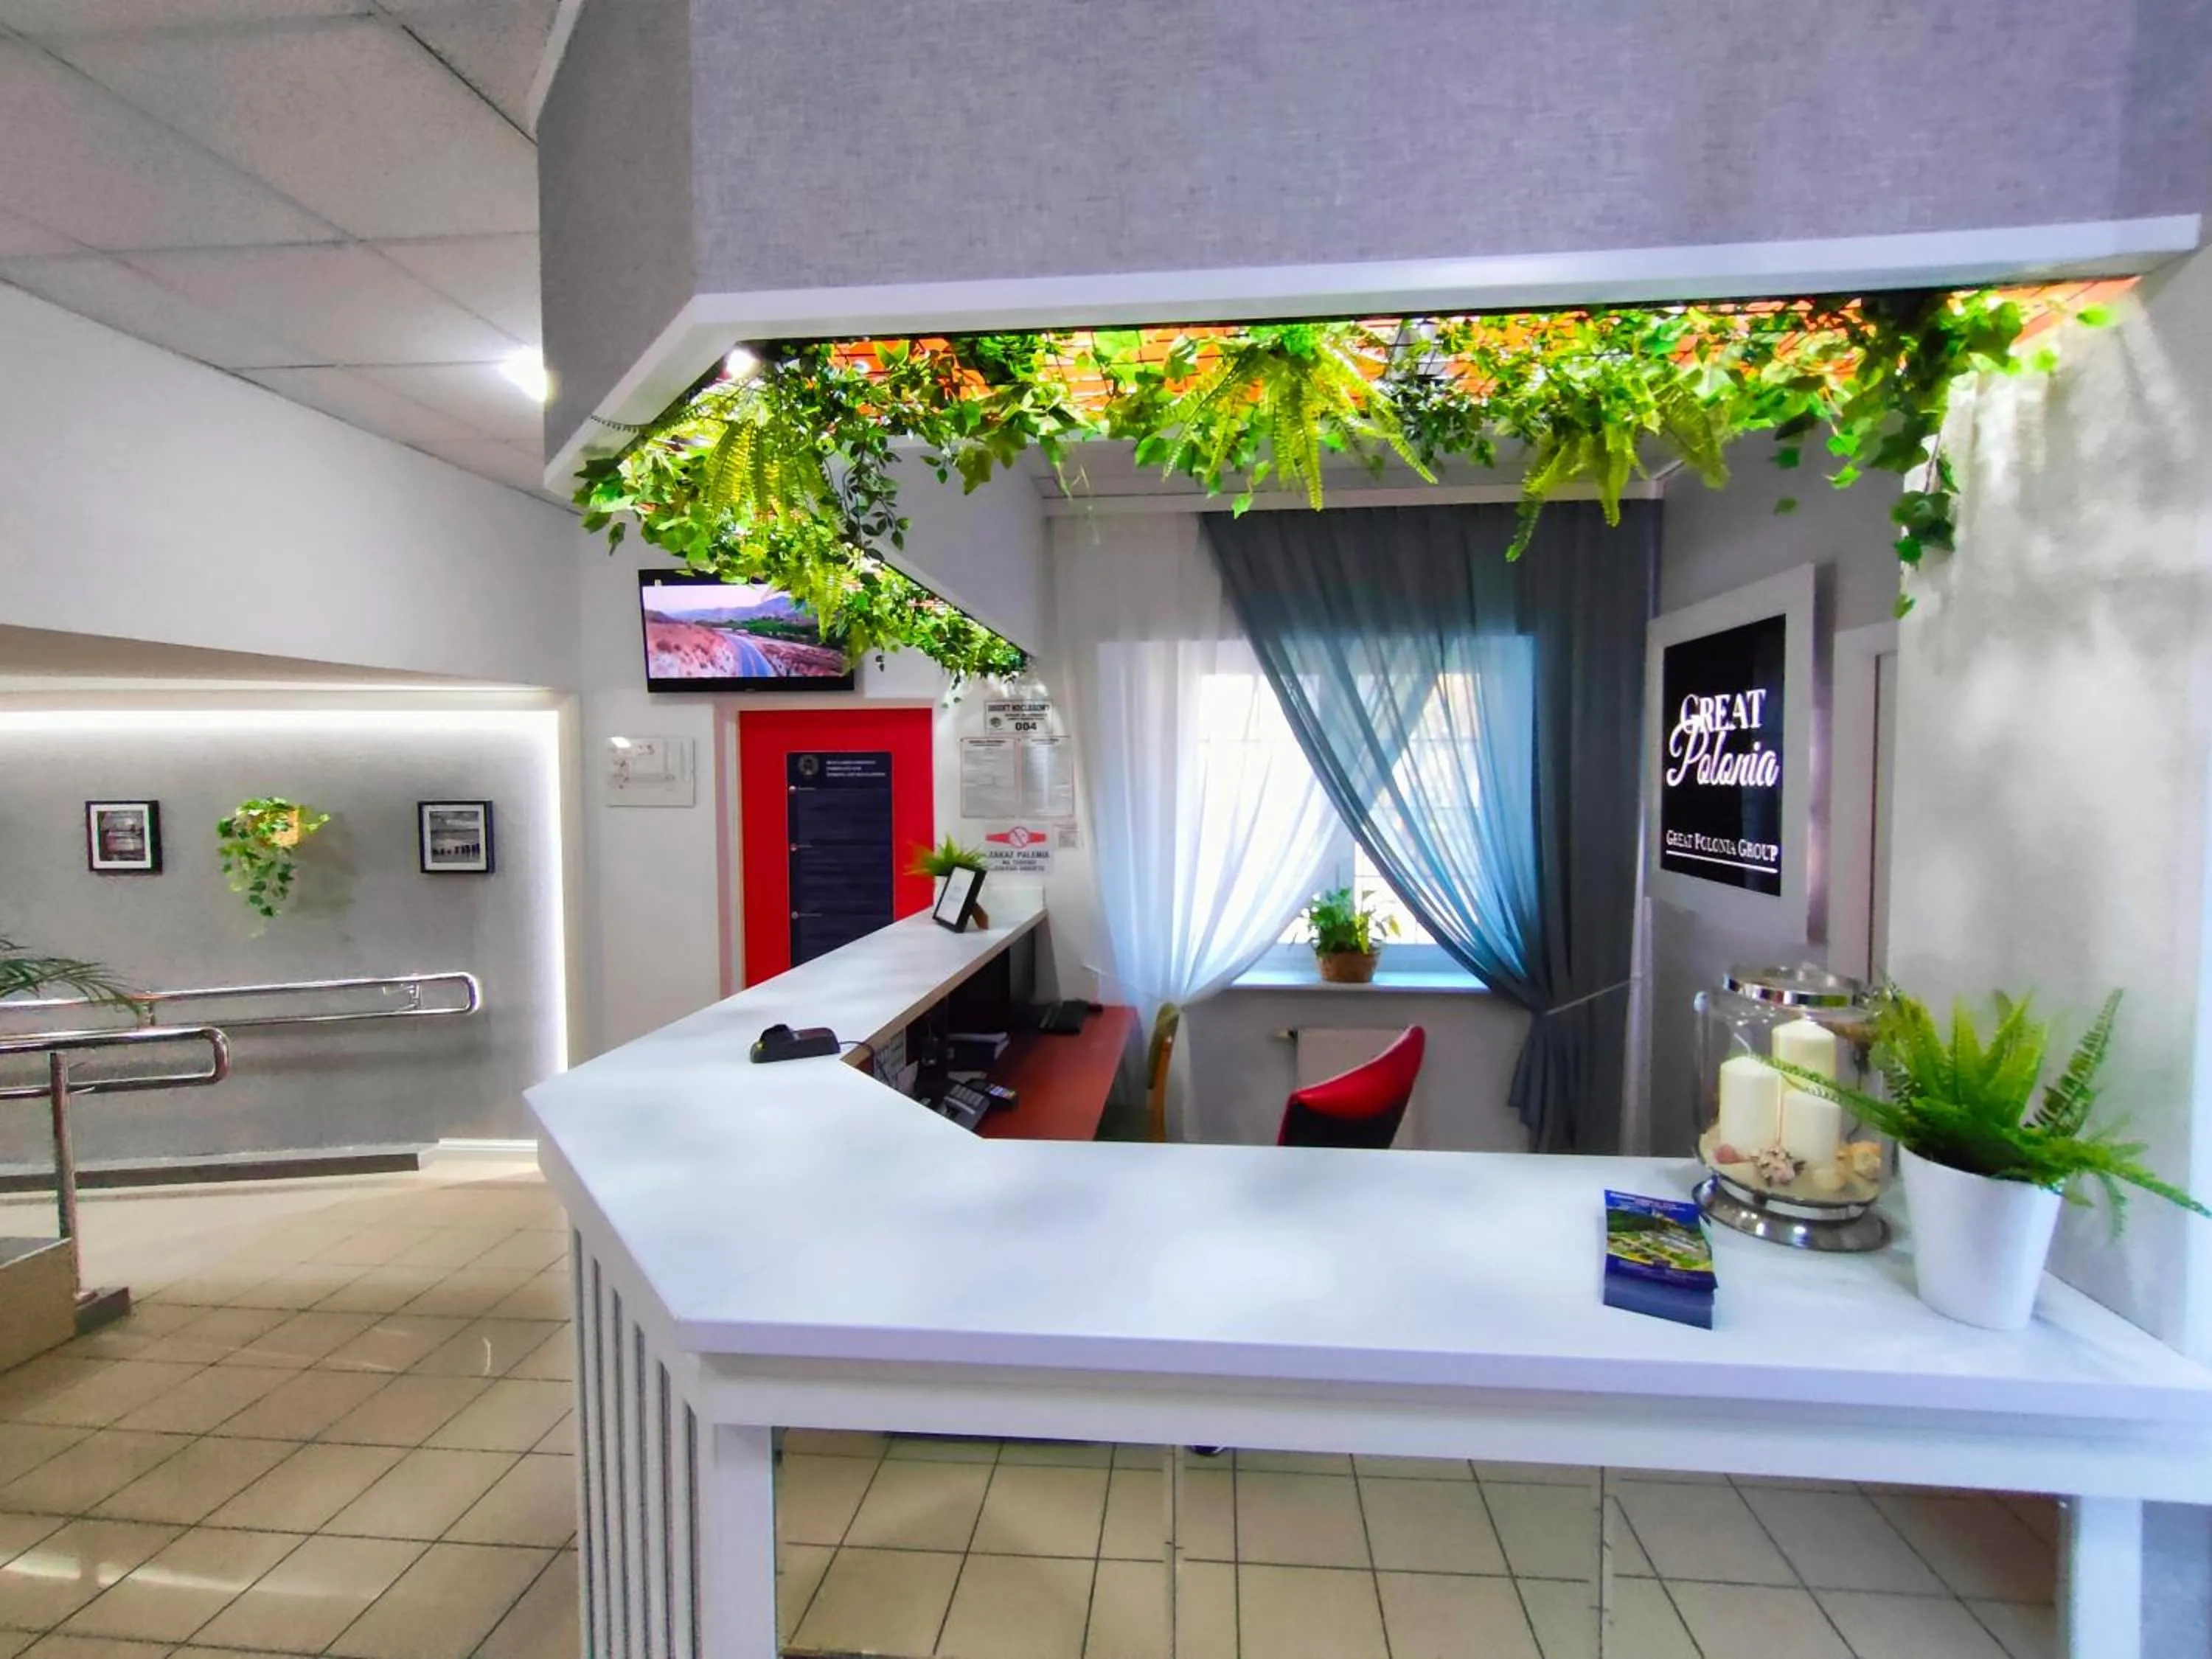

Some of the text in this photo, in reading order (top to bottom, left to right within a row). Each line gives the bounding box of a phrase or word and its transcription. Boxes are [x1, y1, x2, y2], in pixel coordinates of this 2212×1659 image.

[1015, 722, 1037, 731] 004
[1680, 688, 1767, 734] GREAT
[1666, 714, 1780, 787] Polonia
[1738, 838, 1779, 862] GROUP
